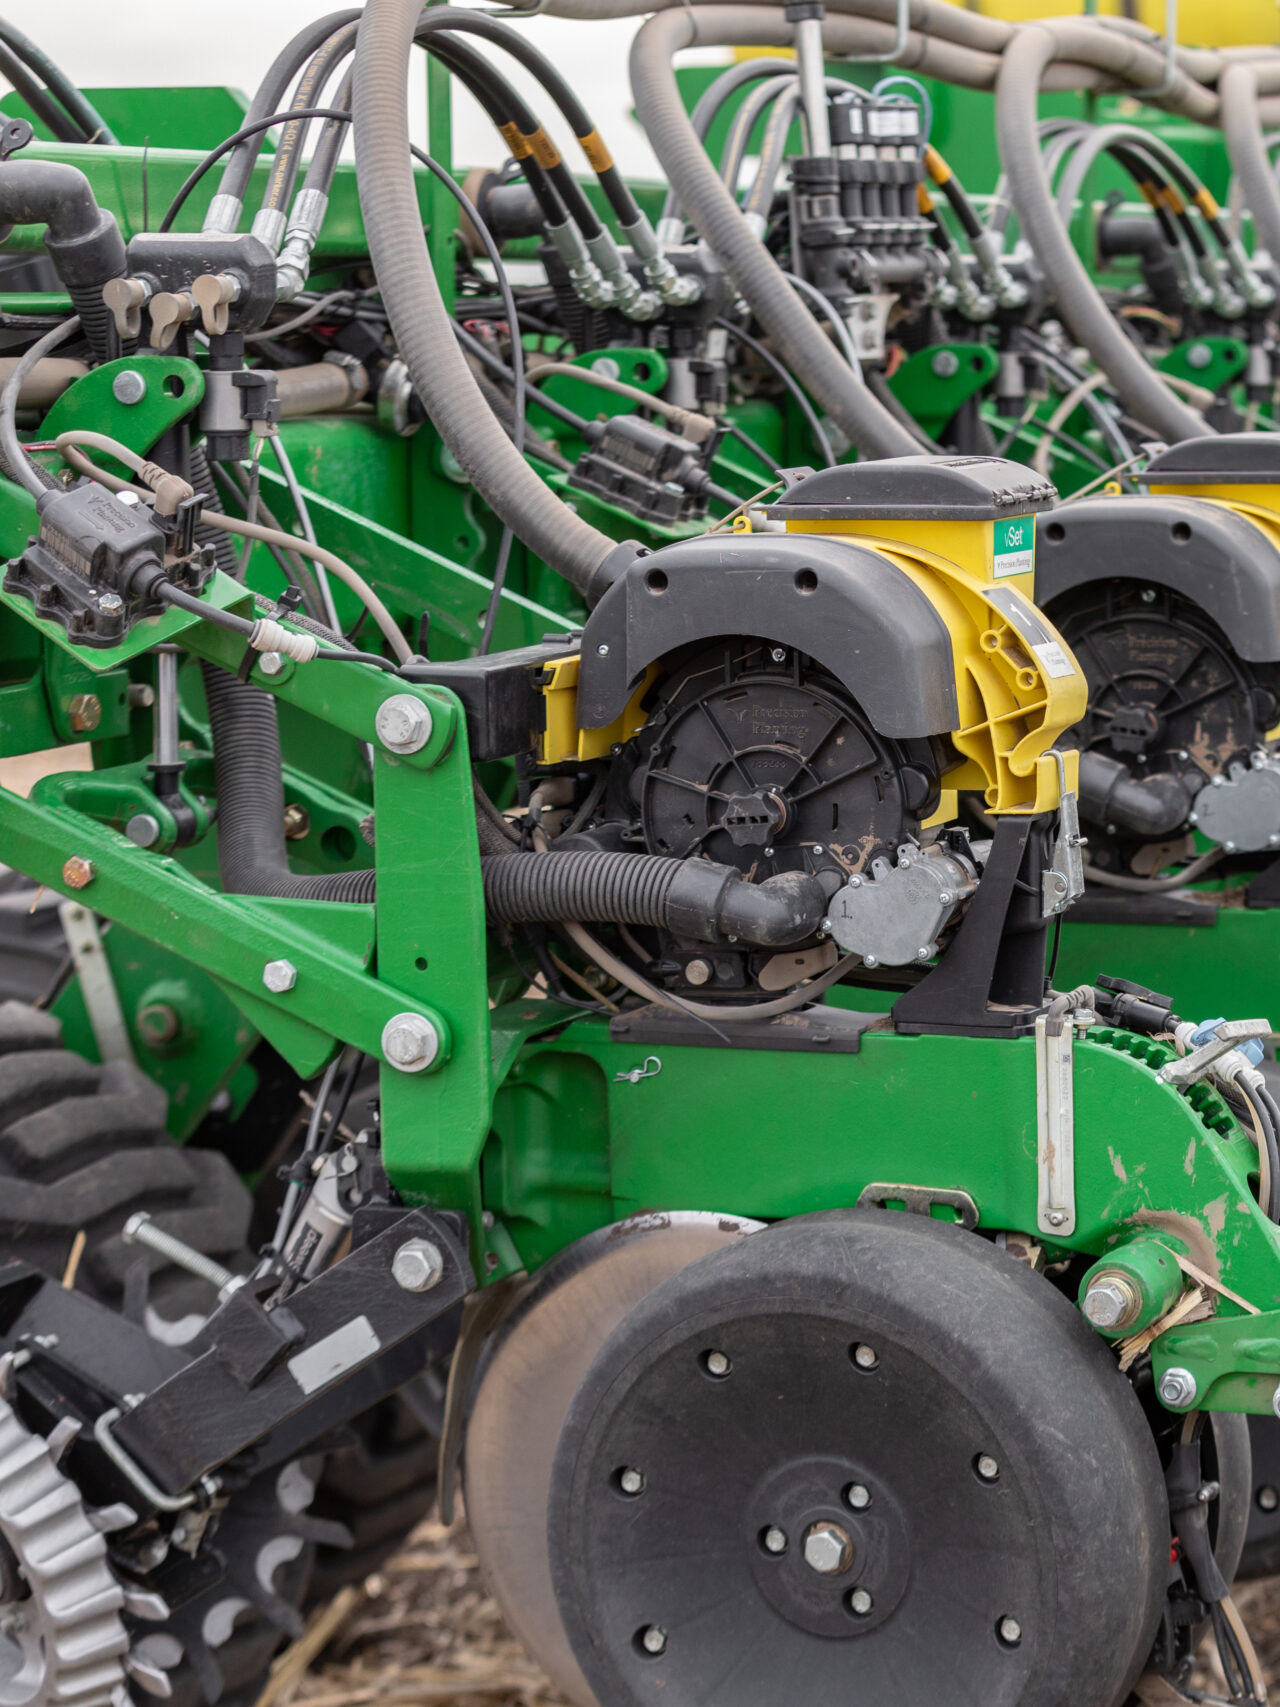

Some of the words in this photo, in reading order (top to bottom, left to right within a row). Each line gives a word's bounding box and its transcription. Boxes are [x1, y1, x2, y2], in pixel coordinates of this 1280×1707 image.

[1004, 525, 1024, 547] vSet
[752, 703, 808, 718] Precision
[752, 721, 808, 739] Planting
